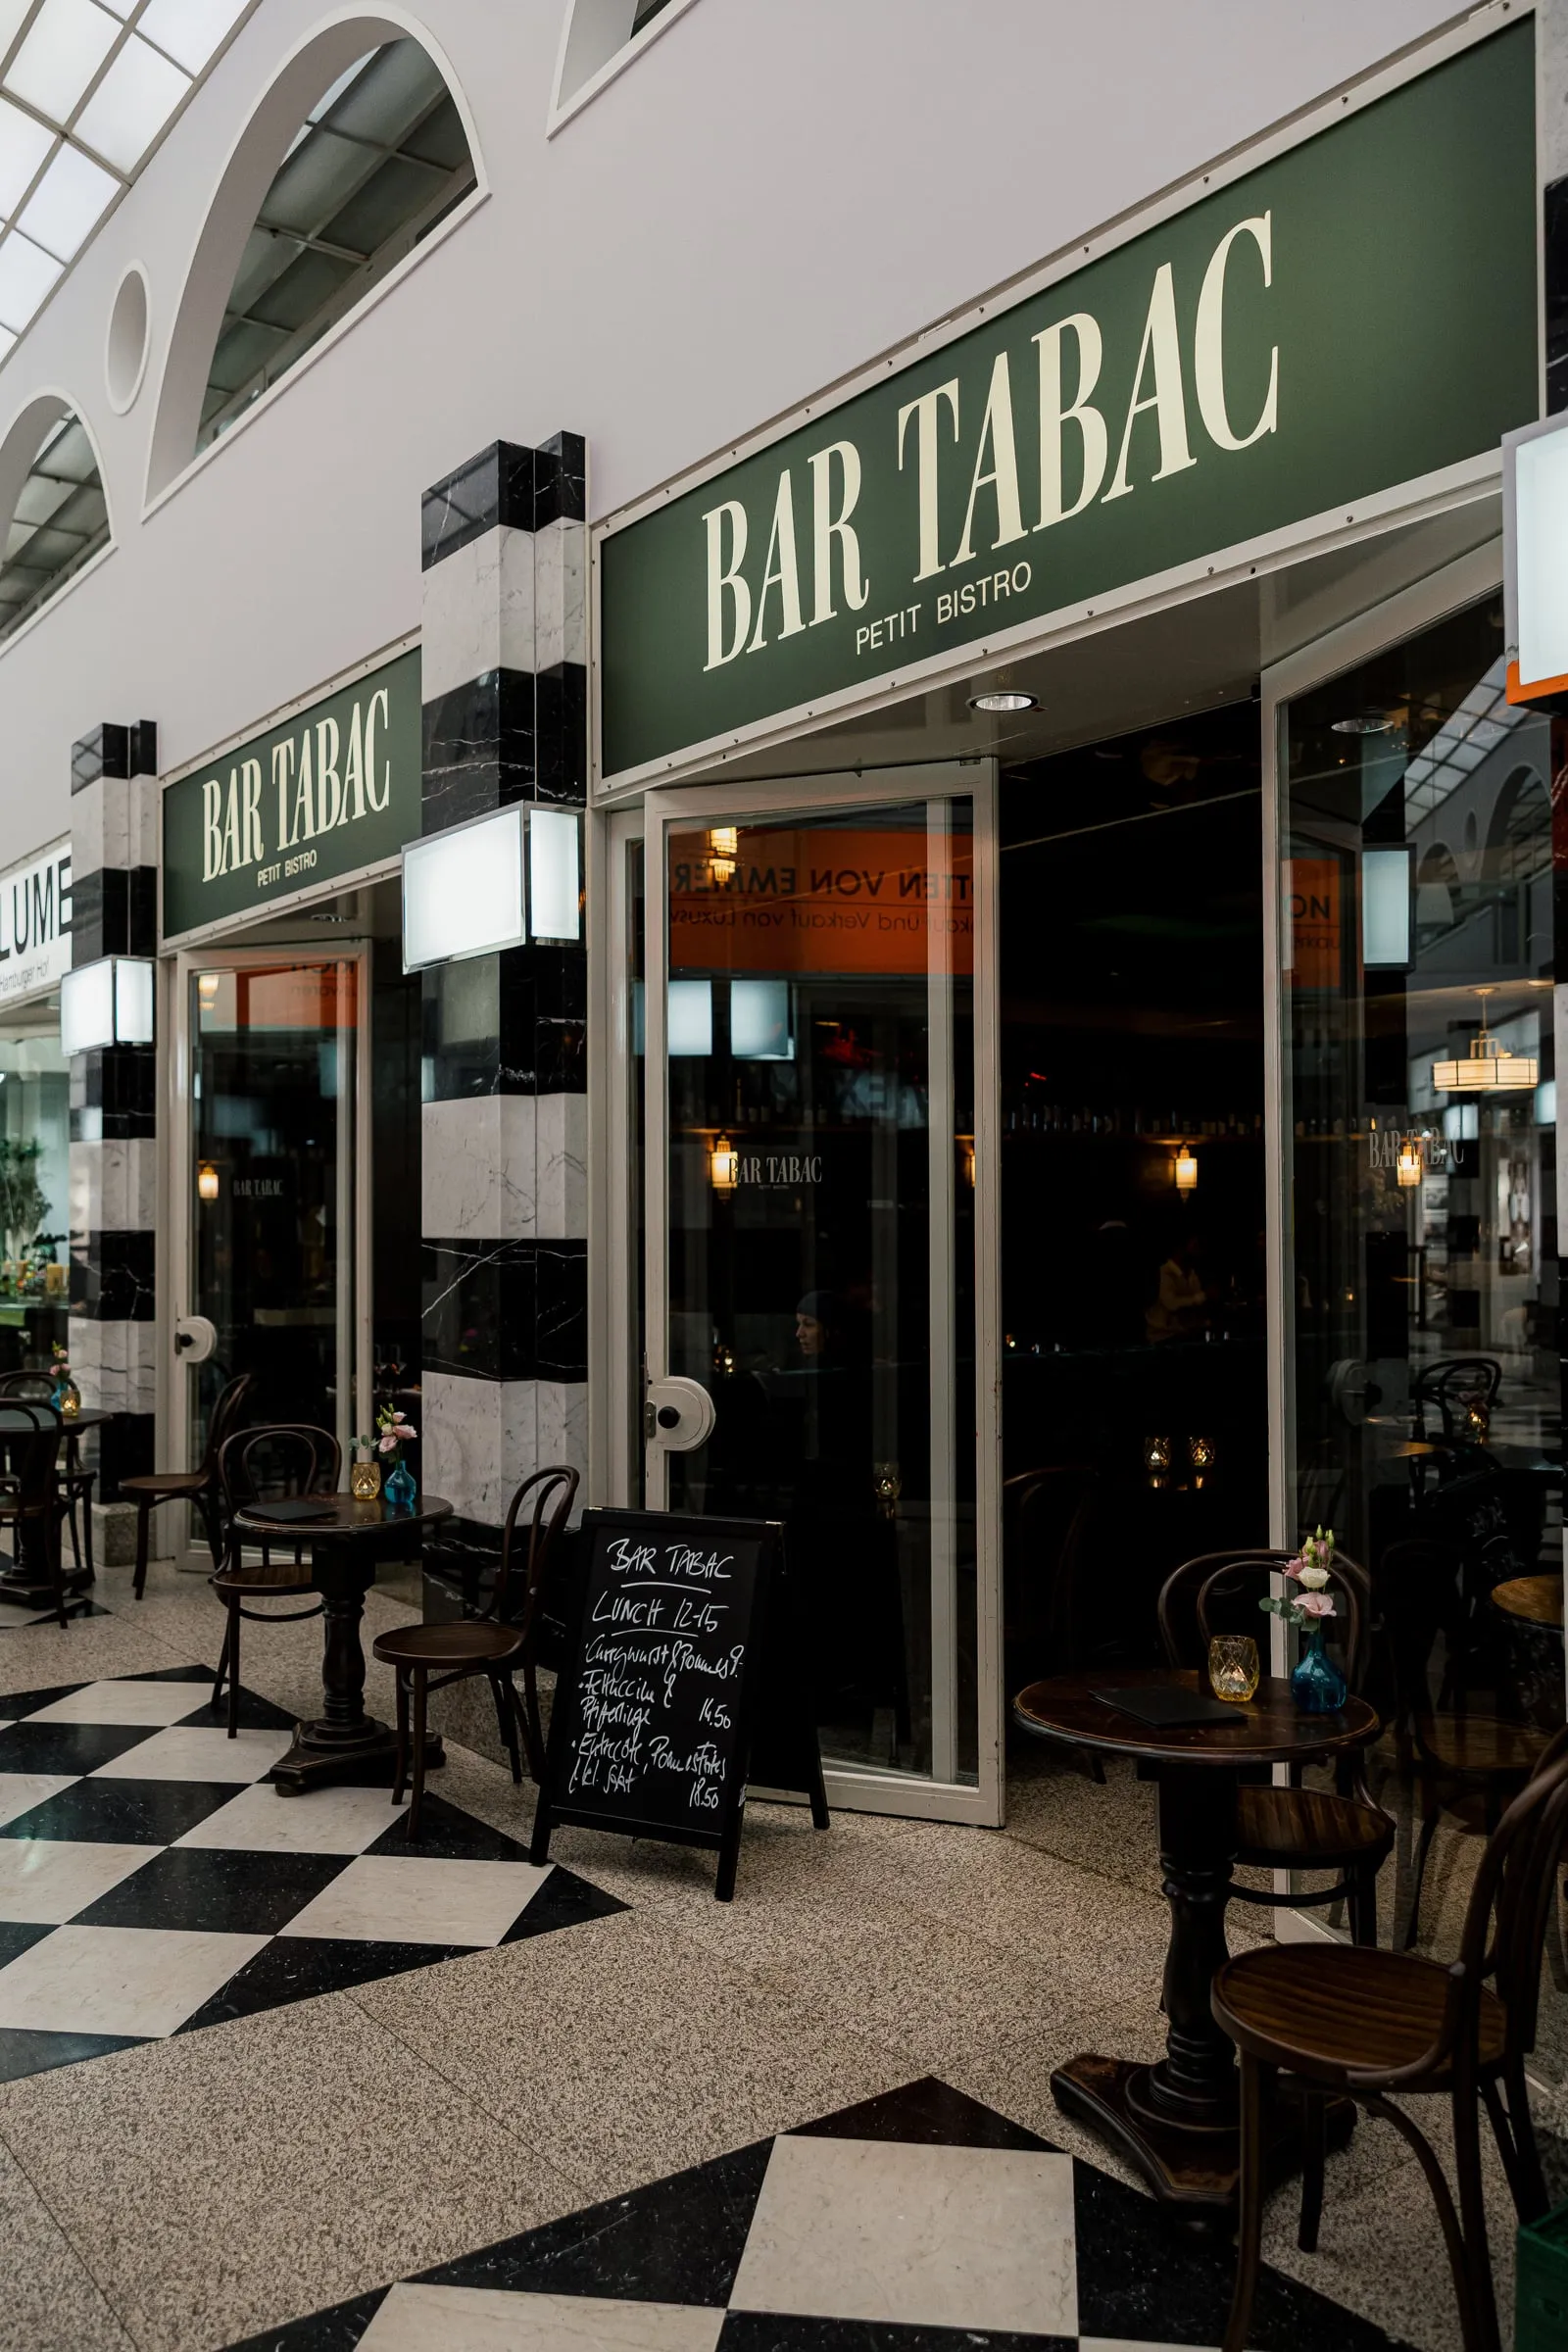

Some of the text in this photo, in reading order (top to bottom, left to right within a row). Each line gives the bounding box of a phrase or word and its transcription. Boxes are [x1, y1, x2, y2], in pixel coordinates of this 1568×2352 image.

[702, 209, 1280, 672] BAR TABAC
[856, 562, 1032, 656] PETIT BISTRO
[202, 688, 390, 883] BAR TABAC
[257, 849, 318, 888] PETIT BISTRO
[1368, 1125, 1464, 1168] BAR TABAC
[233, 1178, 283, 1197] BAR TABAC
[729, 1155, 822, 1184] BAR TABAC
[607, 1539, 735, 1579] BAR TABAC
[592, 1590, 730, 1633] LUNCH 12-15
[698, 1697, 731, 1729] 14.50
[689, 1776, 719, 1809] 18.50
